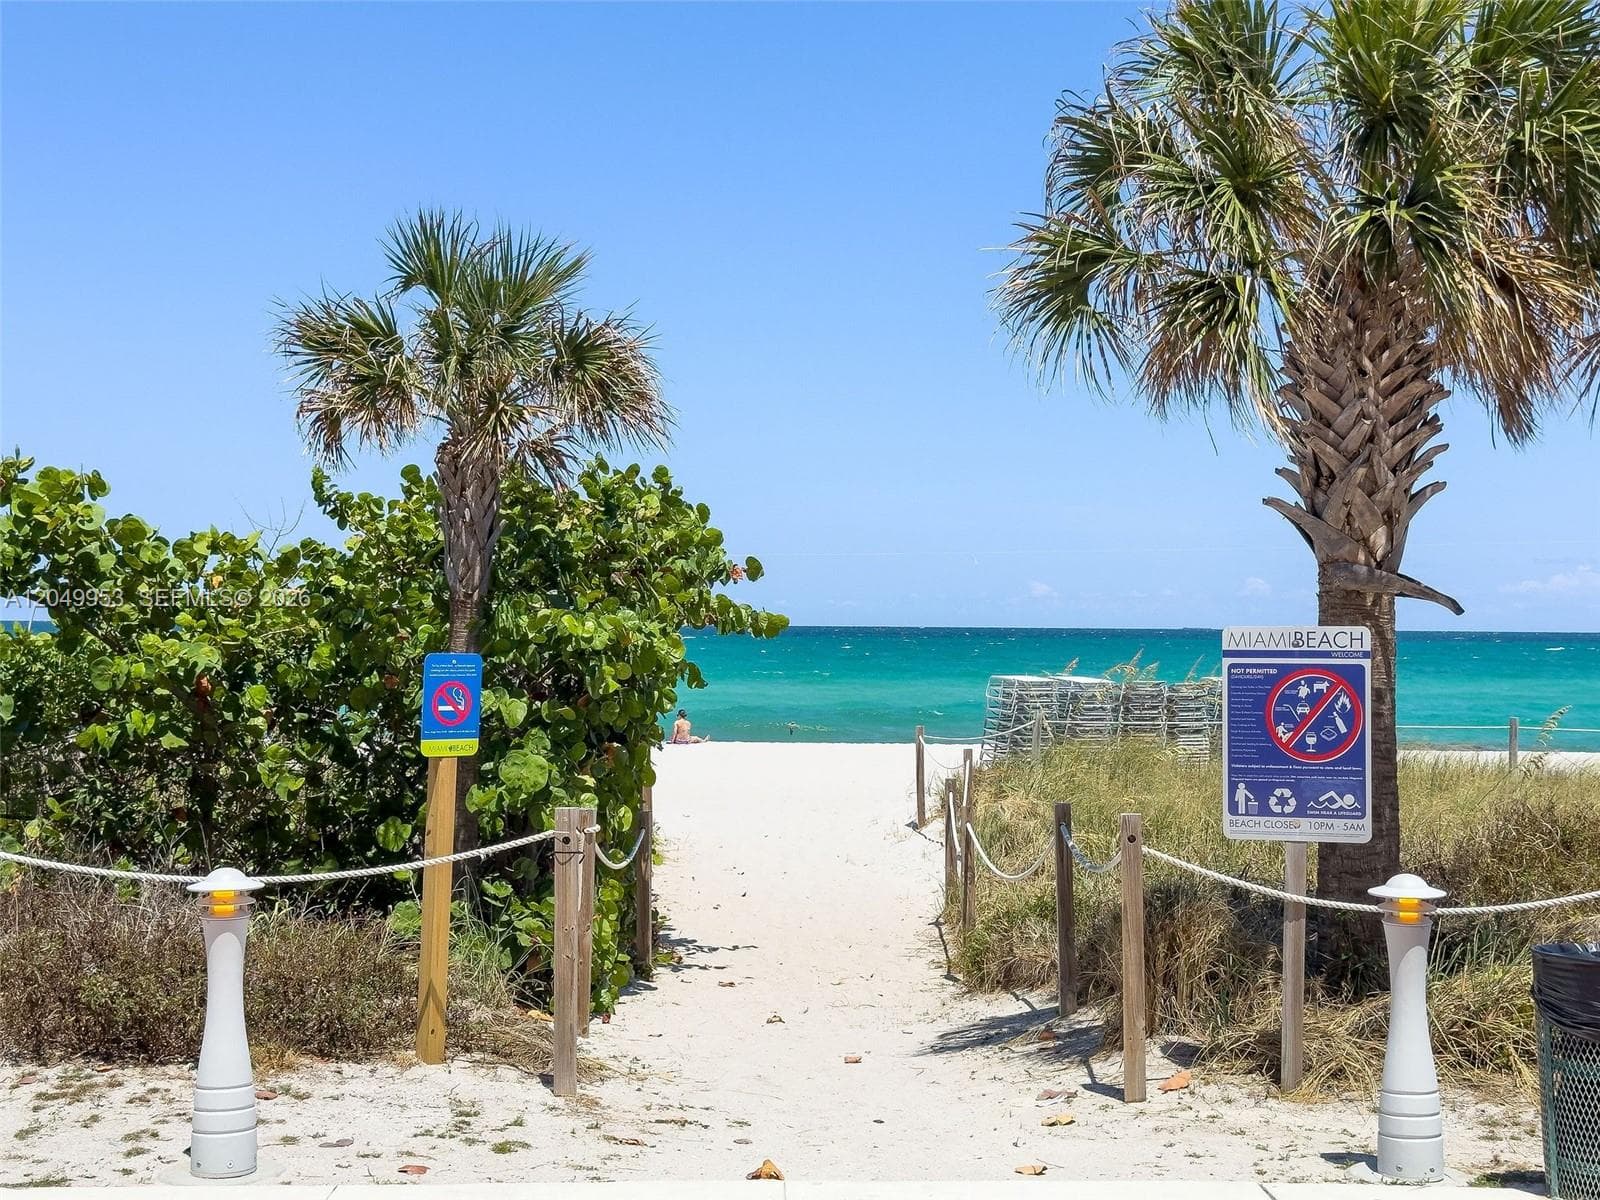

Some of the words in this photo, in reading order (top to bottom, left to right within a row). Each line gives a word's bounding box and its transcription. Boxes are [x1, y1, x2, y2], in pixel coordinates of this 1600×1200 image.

[1229, 819, 1260, 828] BEACH
[1308, 821, 1334, 830] 10PM
[1343, 822, 1366, 831] 5AM
